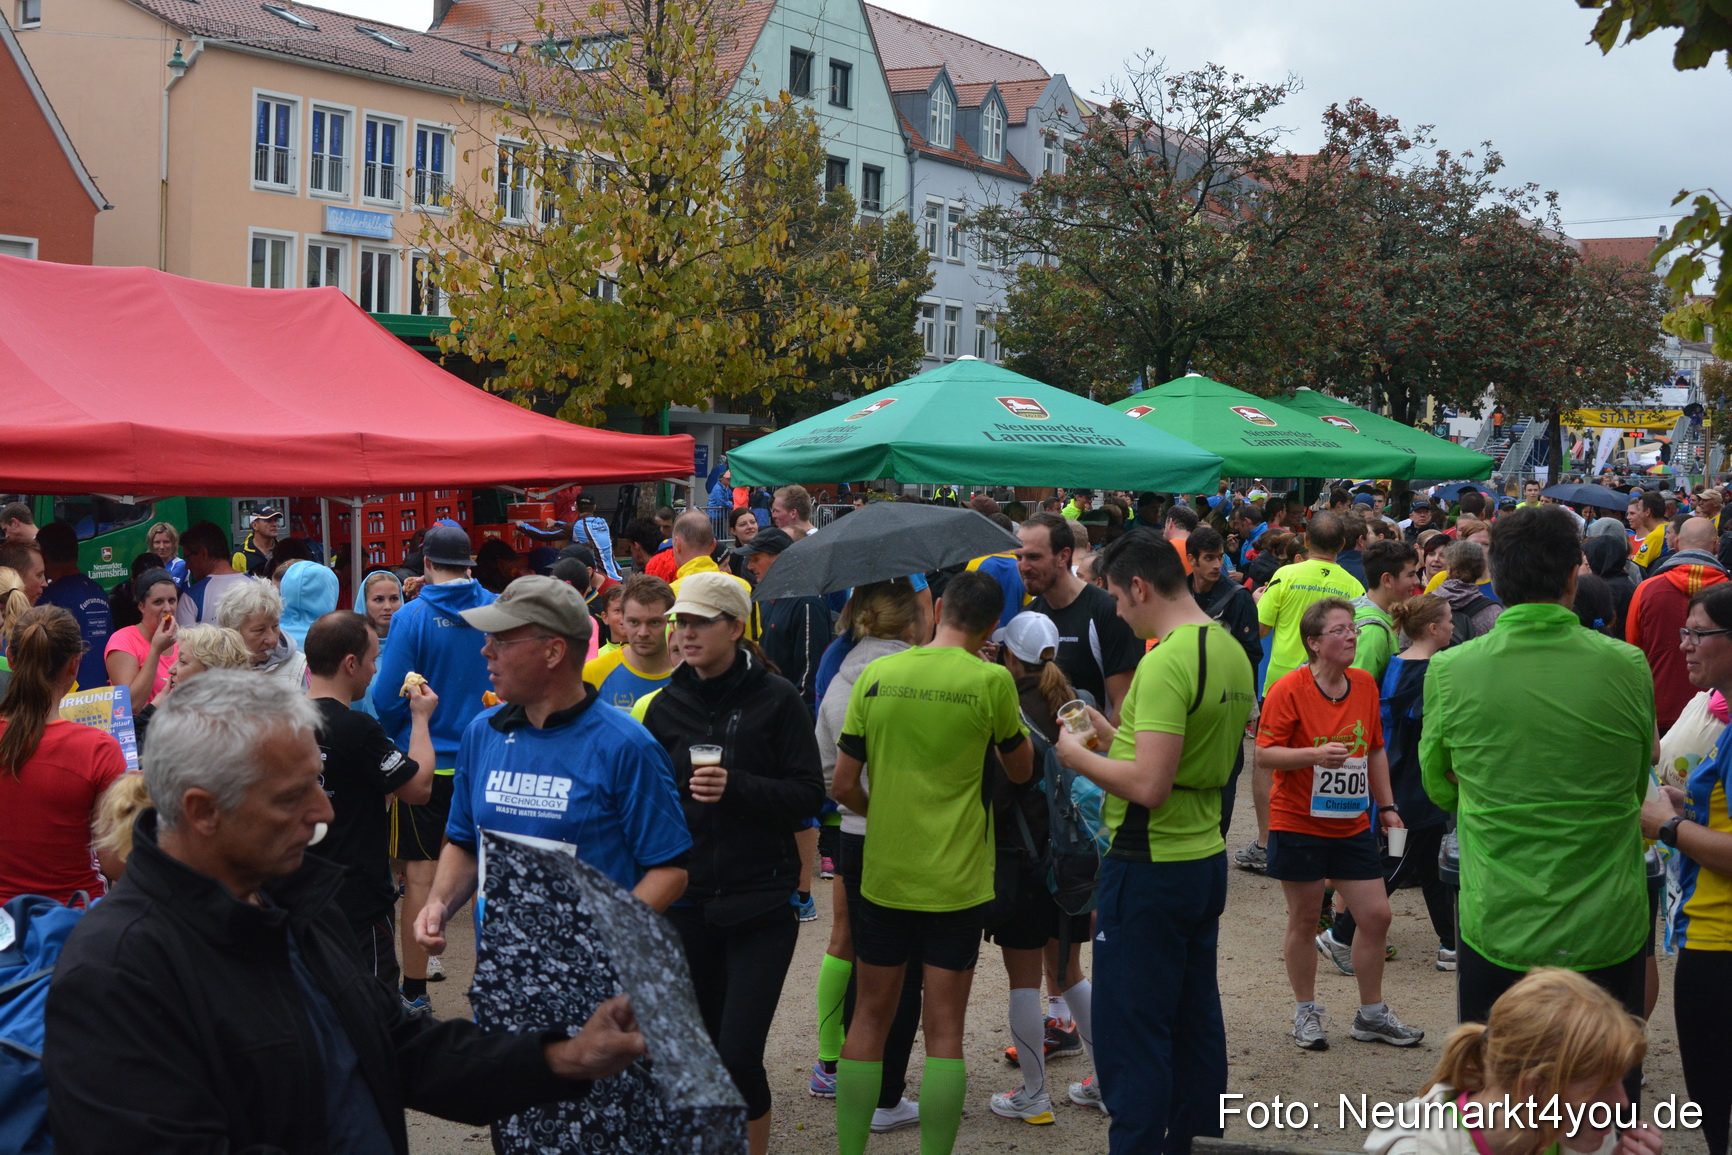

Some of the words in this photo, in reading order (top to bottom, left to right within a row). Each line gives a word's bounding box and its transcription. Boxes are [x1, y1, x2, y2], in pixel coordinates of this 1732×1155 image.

[1599, 412, 1645, 424] START
[993, 423, 1095, 434] Neumarkter
[1243, 430, 1315, 438] Neumarkter
[982, 430, 1127, 447] Lammsbräu
[1240, 437, 1342, 448] Lammsbräu
[93, 562, 122, 571] Neumarkter
[88, 568, 129, 580] Lammsbräu
[880, 685, 917, 699] GOSSEN
[919, 689, 979, 707] METRAWATT
[103, 720, 131, 730] Stadtlauf
[485, 770, 573, 799] HUBER
[1319, 771, 1366, 795] 2509
[499, 794, 564, 809] TECHNOLOGY
[1325, 800, 1361, 810] Christine
[495, 805, 518, 816] WASTE
[518, 808, 537, 818] WATER
[537, 810, 562, 820] Solutions
